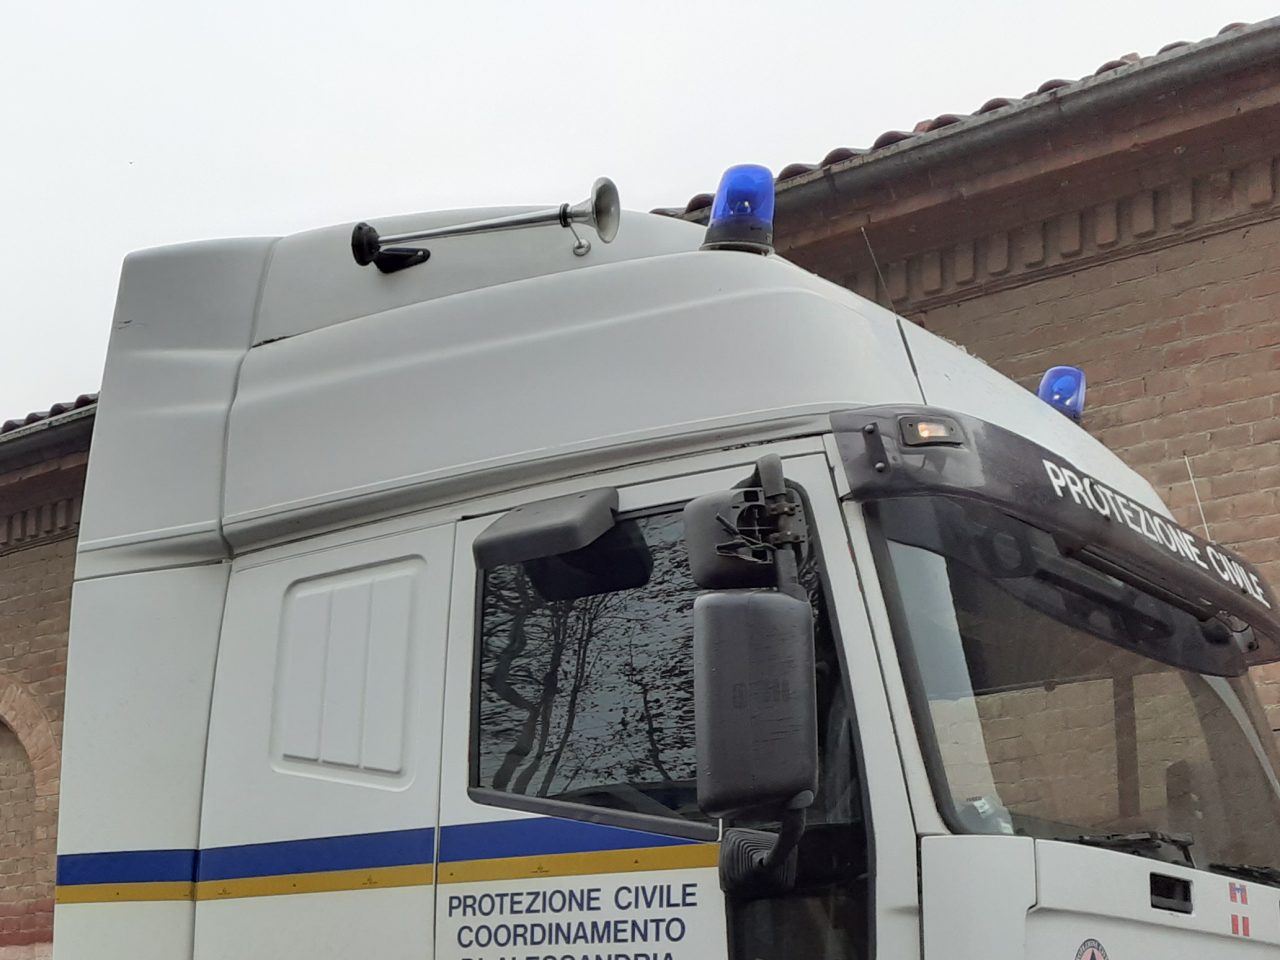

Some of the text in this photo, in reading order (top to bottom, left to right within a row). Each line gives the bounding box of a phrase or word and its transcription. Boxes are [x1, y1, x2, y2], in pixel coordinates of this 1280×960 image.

[1042, 458, 1272, 609] PROTEZIONE CIVILE
[448, 883, 698, 917] PROTEZIONE CIVILE
[456, 917, 687, 949] COORDINAMENTO
